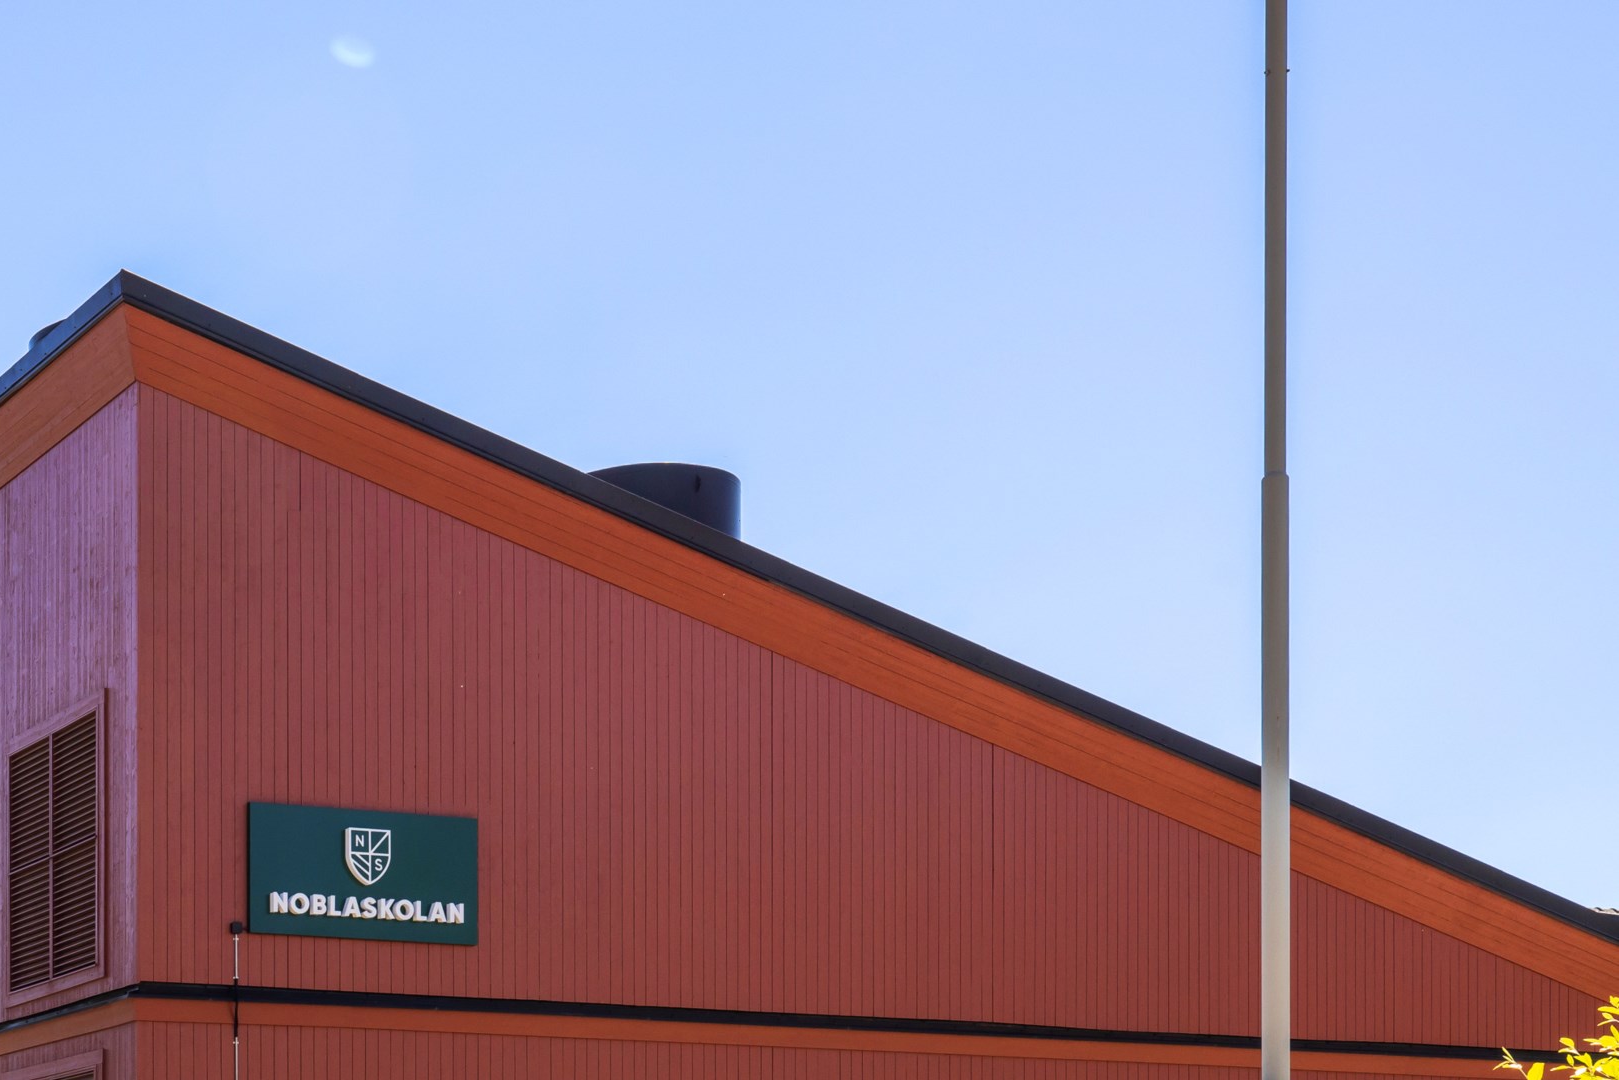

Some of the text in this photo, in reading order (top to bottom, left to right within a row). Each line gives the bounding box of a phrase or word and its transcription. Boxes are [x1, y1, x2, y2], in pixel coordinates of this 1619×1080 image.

[355, 834, 365, 848] N
[374, 859, 383, 872] S
[269, 891, 465, 924] NOBLASKOLAN
